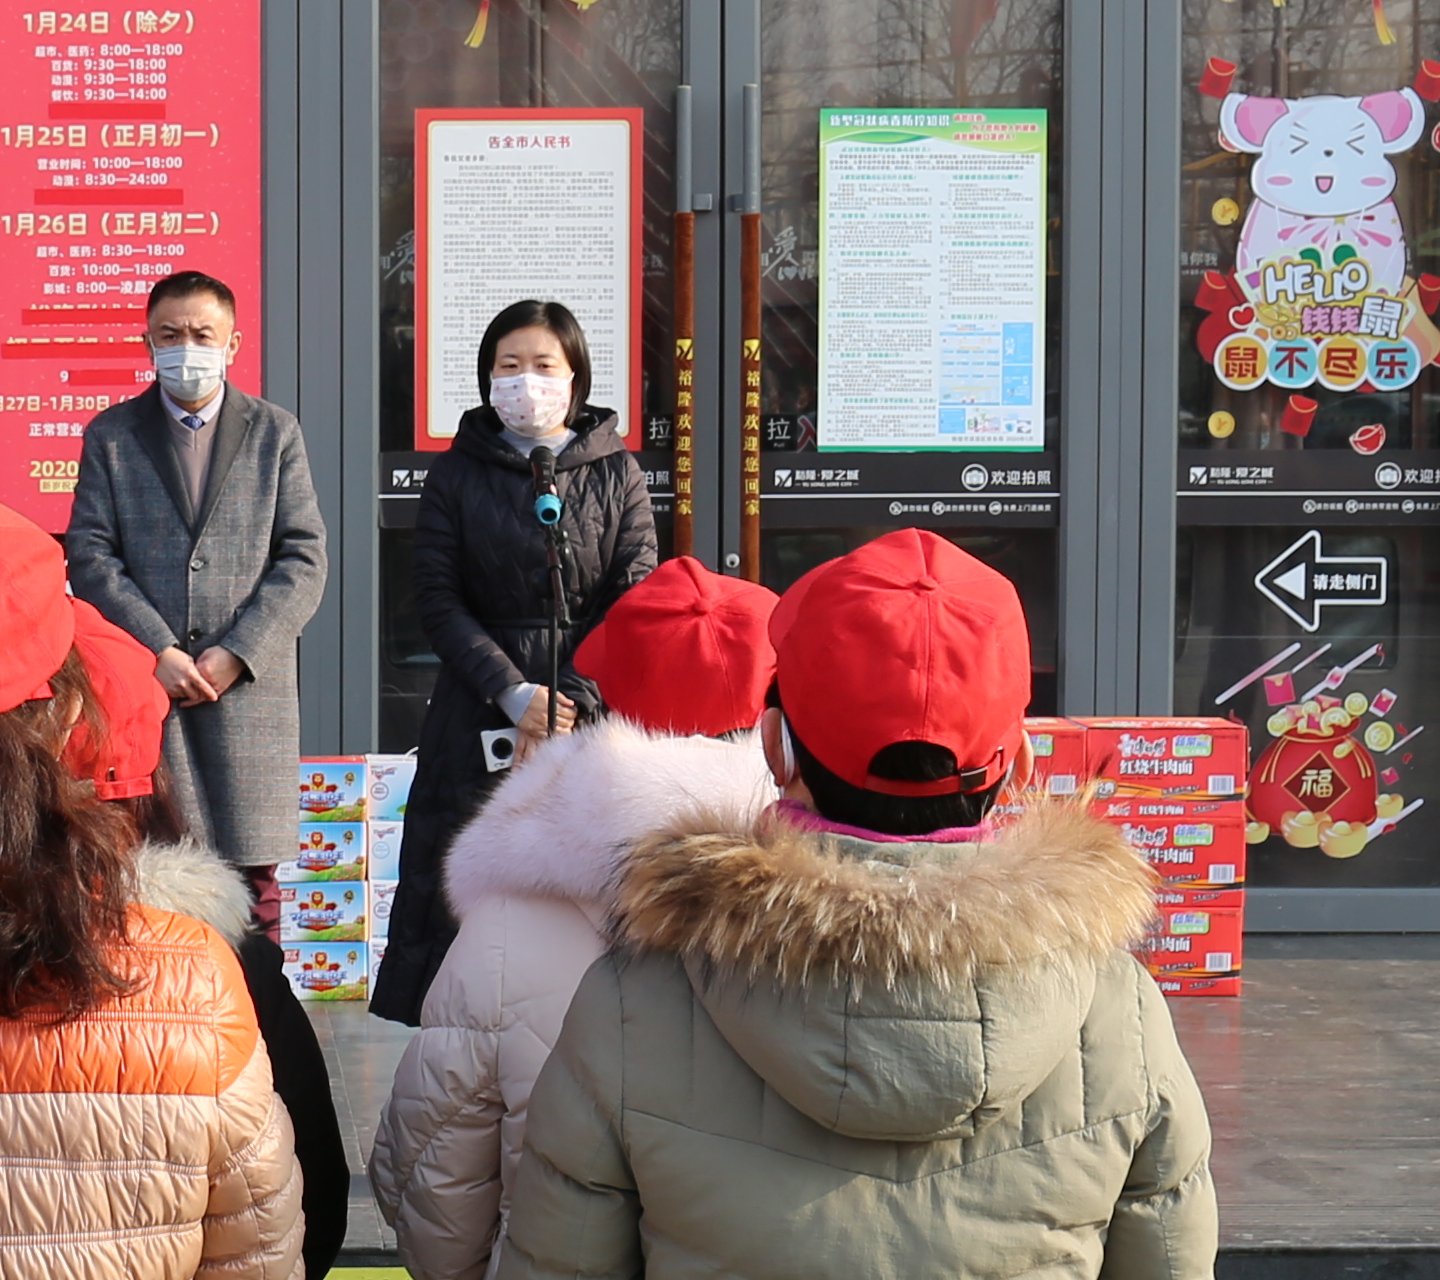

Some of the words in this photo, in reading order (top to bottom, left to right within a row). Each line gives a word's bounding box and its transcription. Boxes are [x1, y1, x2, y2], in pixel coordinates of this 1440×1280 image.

[487, 135, 573, 150] 告全市人民书
[1263, 260, 1371, 306] HELLO
[1223, 345, 1411, 381] 鼠不尽乐
[28, 422, 84, 438] 正常营业
[648, 417, 673, 441] 拉
[767, 418, 792, 441] 拉
[29, 460, 79, 478] 2020
[990, 470, 1052, 486] 欢迎拍照
[1312, 573, 1377, 592] 请走侧门
[1119, 759, 1195, 776] 红烧牛肉面
[1299, 769, 1334, 800] 福
